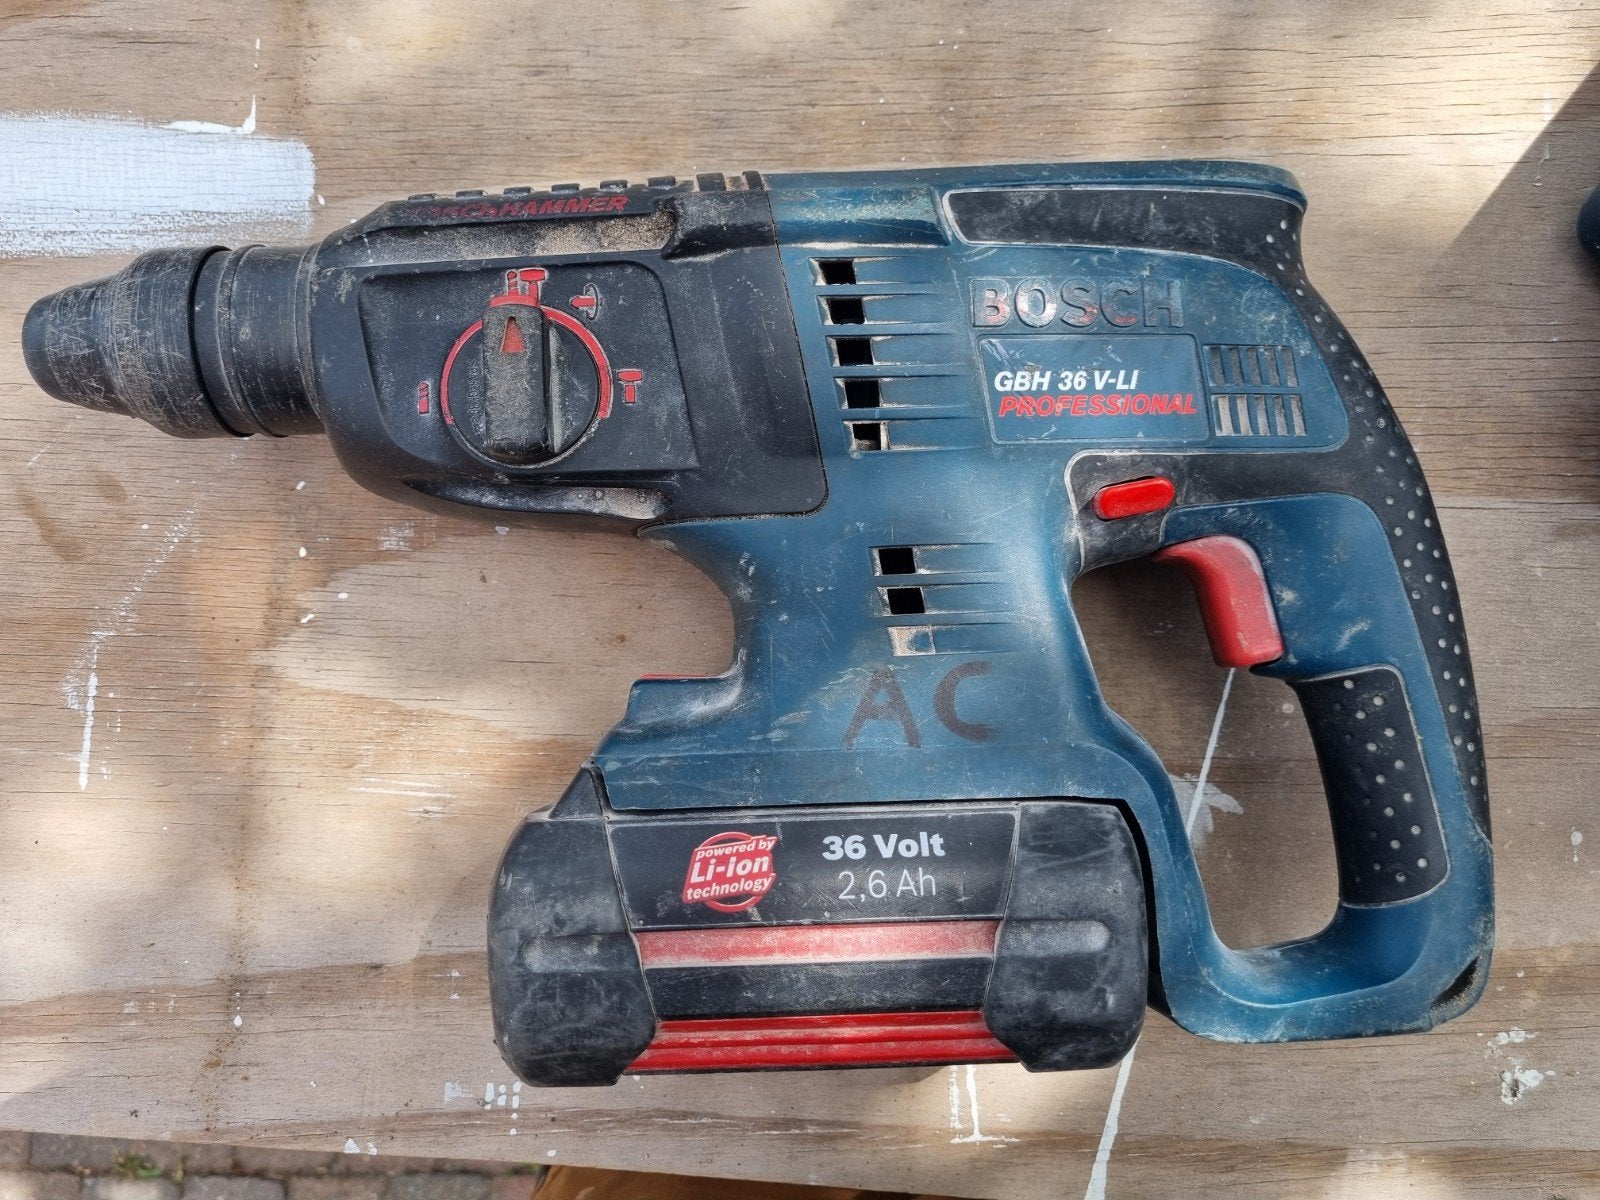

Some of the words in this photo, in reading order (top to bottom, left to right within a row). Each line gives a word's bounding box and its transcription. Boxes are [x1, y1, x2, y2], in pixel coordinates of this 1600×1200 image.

[971, 277, 1184, 328] BOSCH
[994, 371, 1051, 392] GBH
[1058, 371, 1087, 390] 36
[1094, 370, 1139, 390] V-LI
[998, 393, 1197, 417] PROFESSIONAL
[695, 841, 756, 861] powered
[757, 838, 775, 851] by
[822, 835, 867, 861] 36
[873, 831, 946, 859] Volt
[690, 855, 770, 884] Li-Ion
[686, 876, 772, 900] technology
[838, 870, 887, 902] 2,6
[896, 867, 937, 898] Ah
